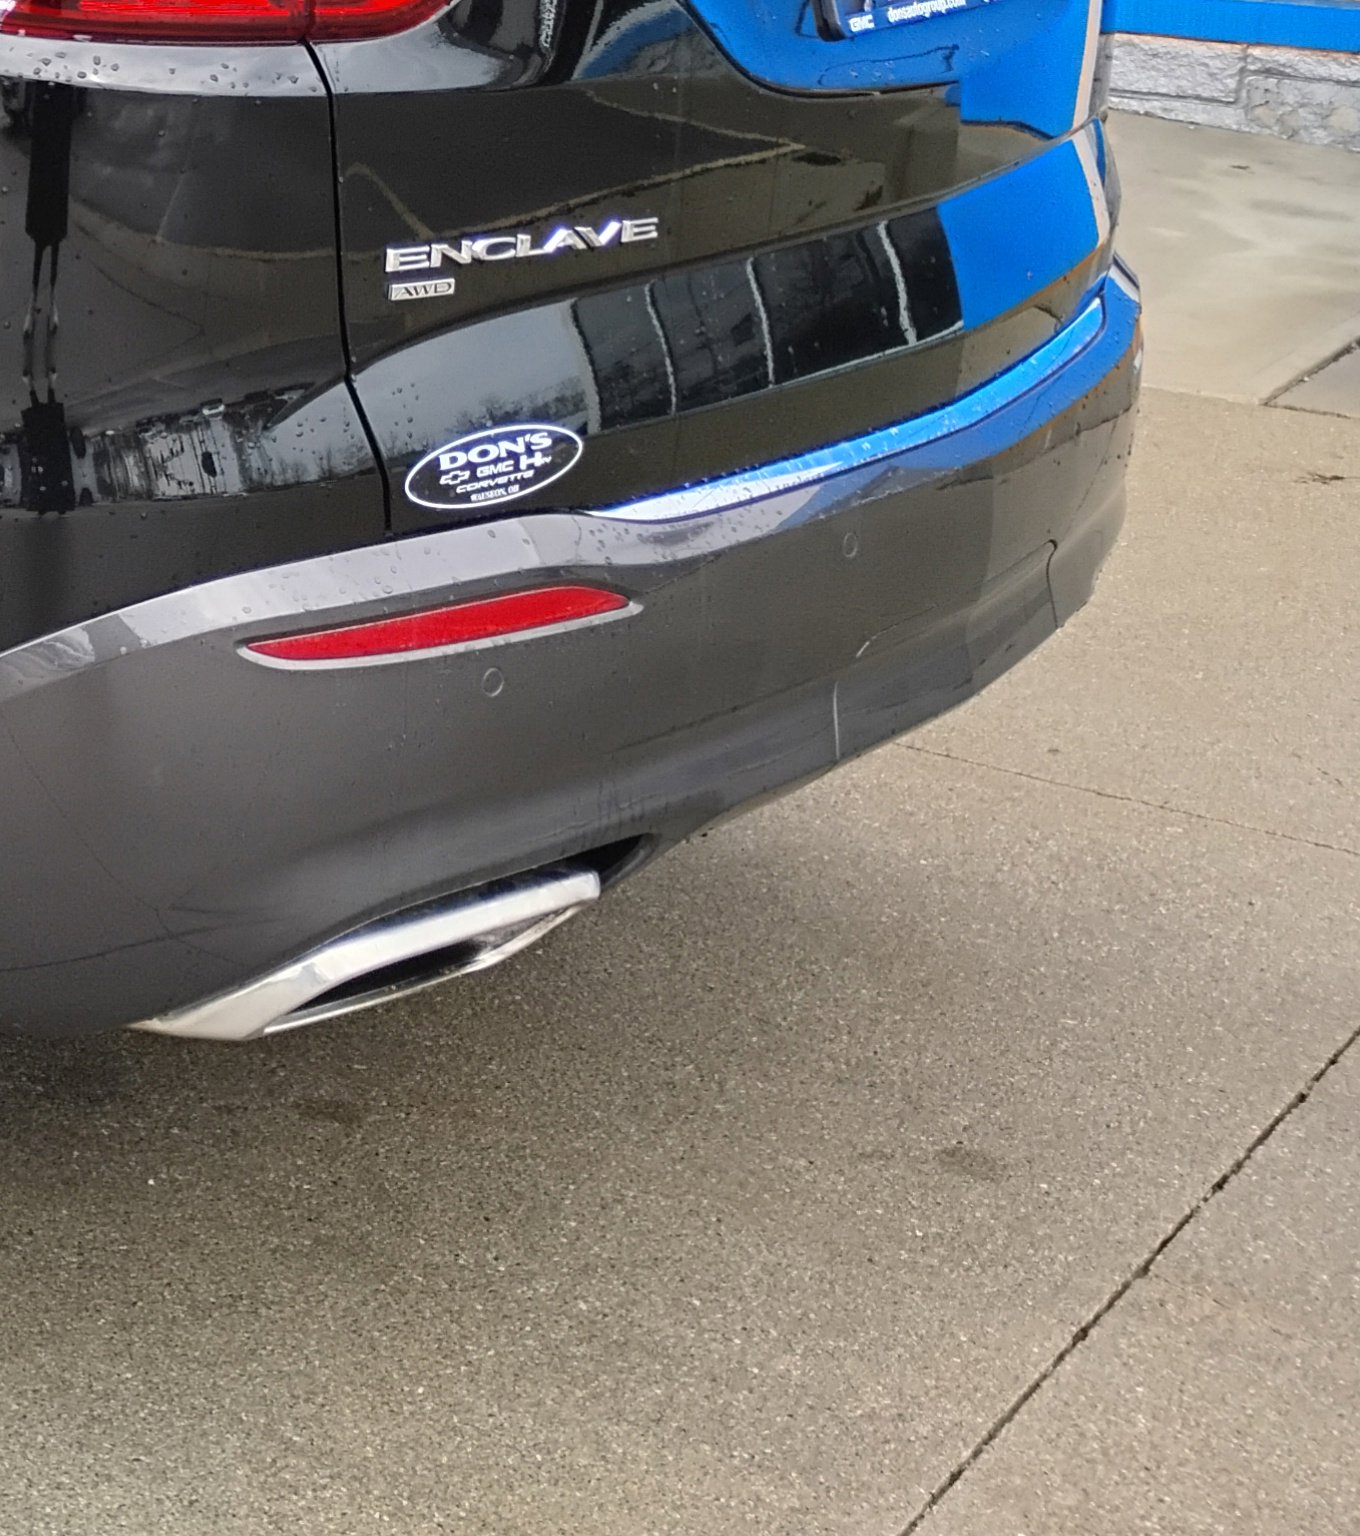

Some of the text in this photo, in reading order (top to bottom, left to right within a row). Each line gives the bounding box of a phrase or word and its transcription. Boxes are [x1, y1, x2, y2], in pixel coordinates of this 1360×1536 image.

[384, 216, 659, 273] ENCLAVE
[391, 280, 454, 299] AWD
[438, 431, 553, 470] DON'S
[476, 460, 515, 477] GMC
[455, 469, 535, 494] CORVETTE
